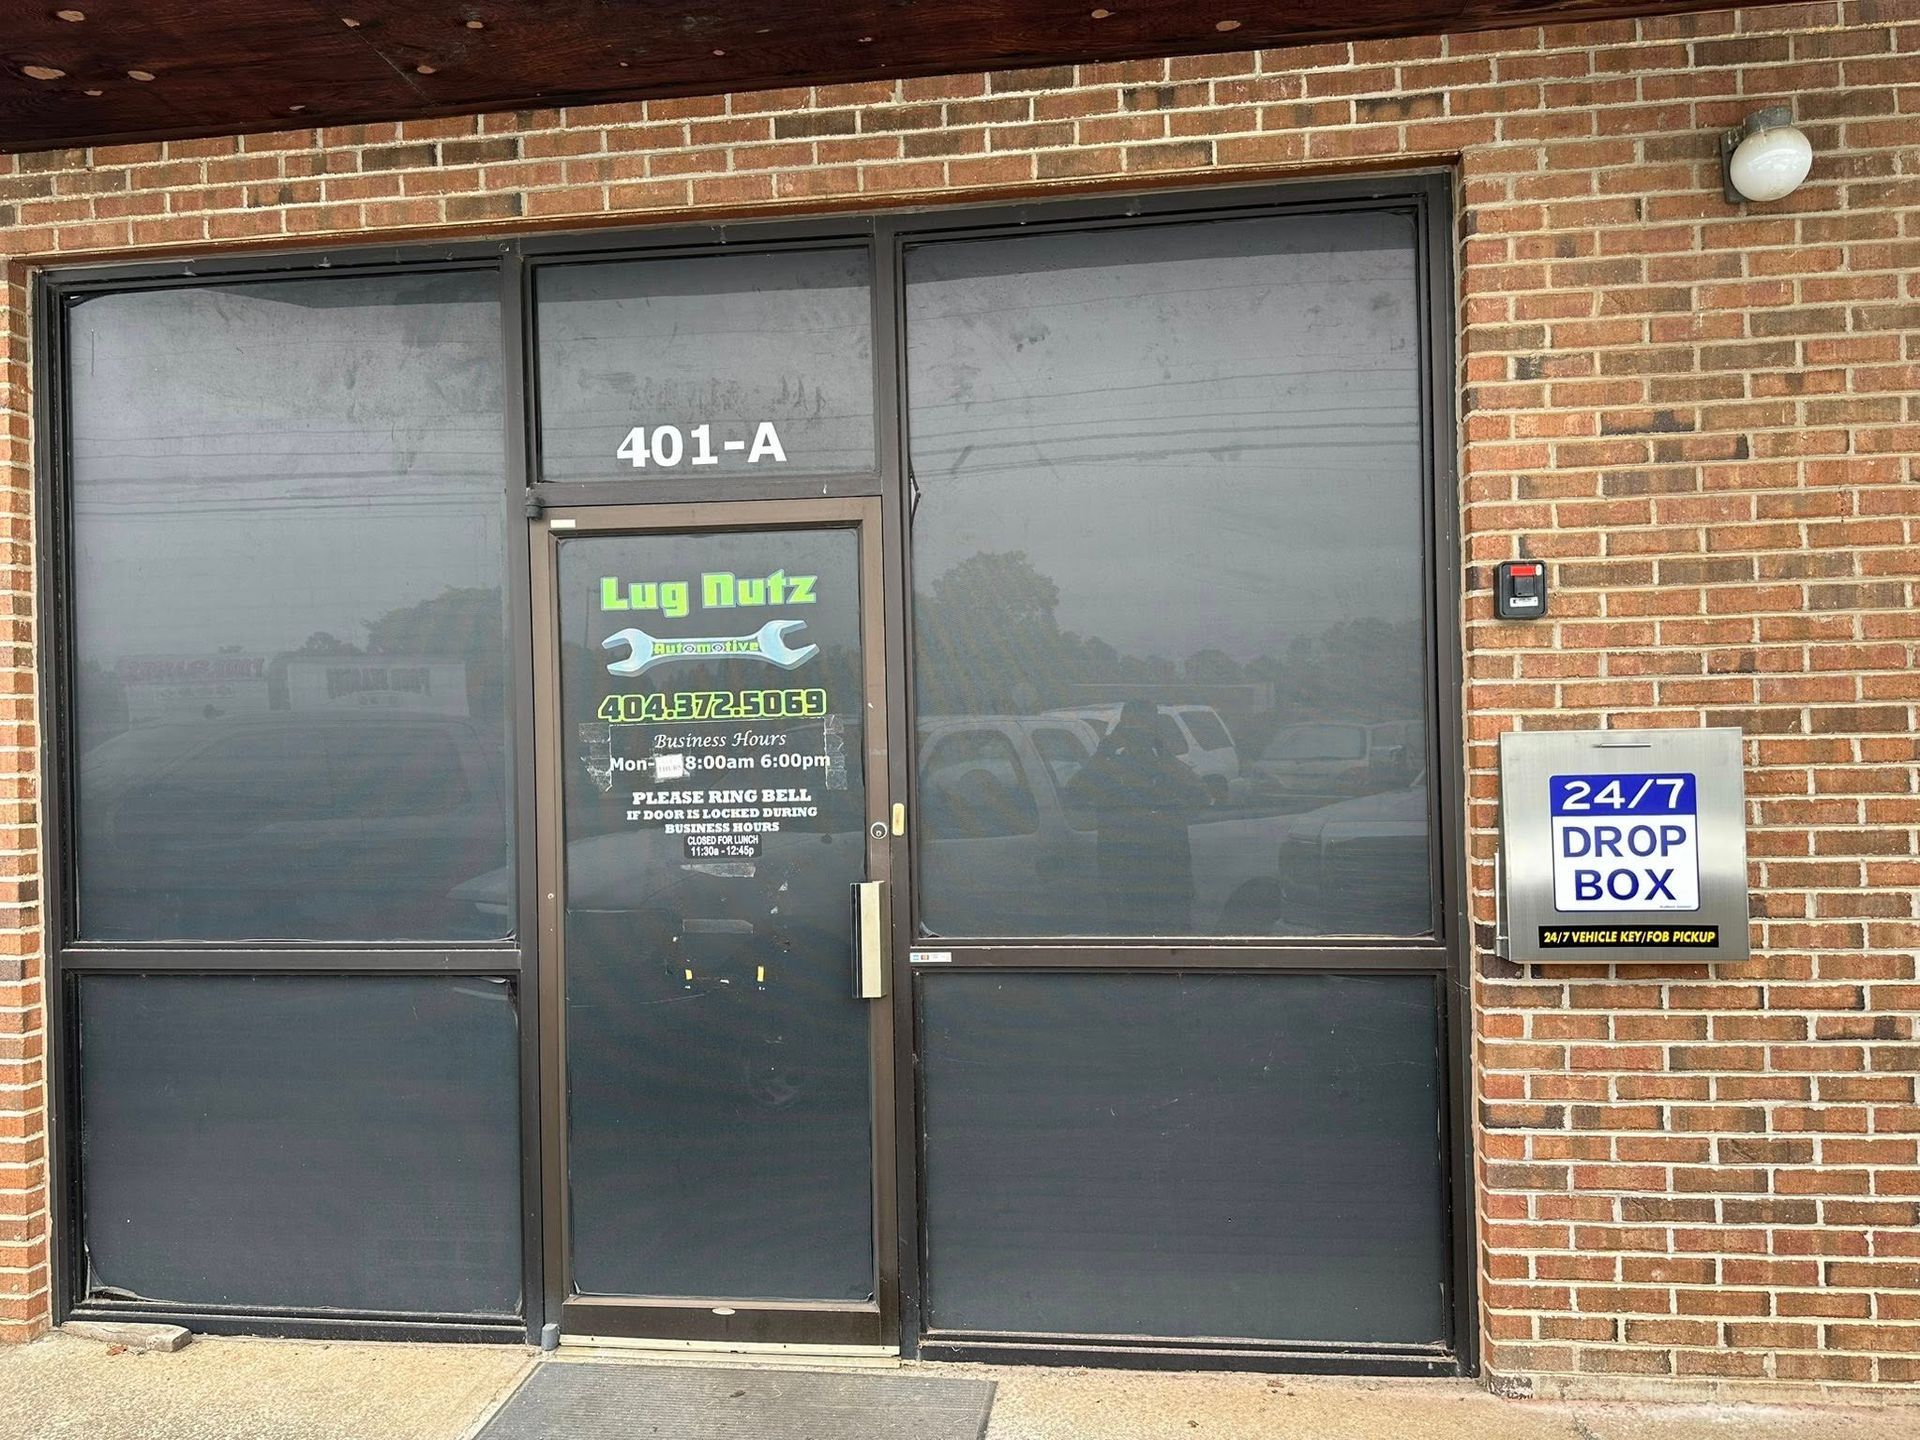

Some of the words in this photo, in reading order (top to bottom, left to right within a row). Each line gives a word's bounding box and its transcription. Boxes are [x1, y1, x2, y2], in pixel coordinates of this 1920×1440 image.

[616, 421, 788, 468] 401-A
[600, 576, 690, 618] Lug
[701, 569, 818, 609] Nutz
[653, 639, 760, 655] Automotive
[597, 688, 828, 723] 404.372.5069
[654, 733, 727, 749] Business
[732, 730, 787, 747] Hours
[610, 757, 655, 772] Mon-
[685, 755, 755, 770] 8:00am
[760, 753, 831, 770] 6:00pm
[632, 790, 704, 805] PLEASE
[708, 789, 758, 803] RING
[761, 788, 812, 802] BELL
[1562, 778, 1685, 810] 24/7
[626, 810, 641, 821] IF
[643, 809, 684, 820] DOOR
[686, 809, 700, 819] IS
[702, 808, 760, 819] LOCKED
[762, 806, 818, 818] DURING
[664, 822, 730, 834] BUSINESS
[732, 821, 780, 833] HOURS
[687, 835, 717, 846] CLOSED
[717, 835, 734, 845] FOR
[734, 834, 759, 844] LUNCH
[1562, 824, 1687, 858] DROP
[691, 846, 719, 857] 11:30a
[726, 845, 755, 857] 12:45p
[1574, 868, 1677, 901] BOX
[1544, 931, 1570, 944] 24/7
[1572, 931, 1618, 943] VEHICLE
[1619, 931, 1671, 943] KEY/FOB
[1672, 931, 1716, 943] PICKUP
